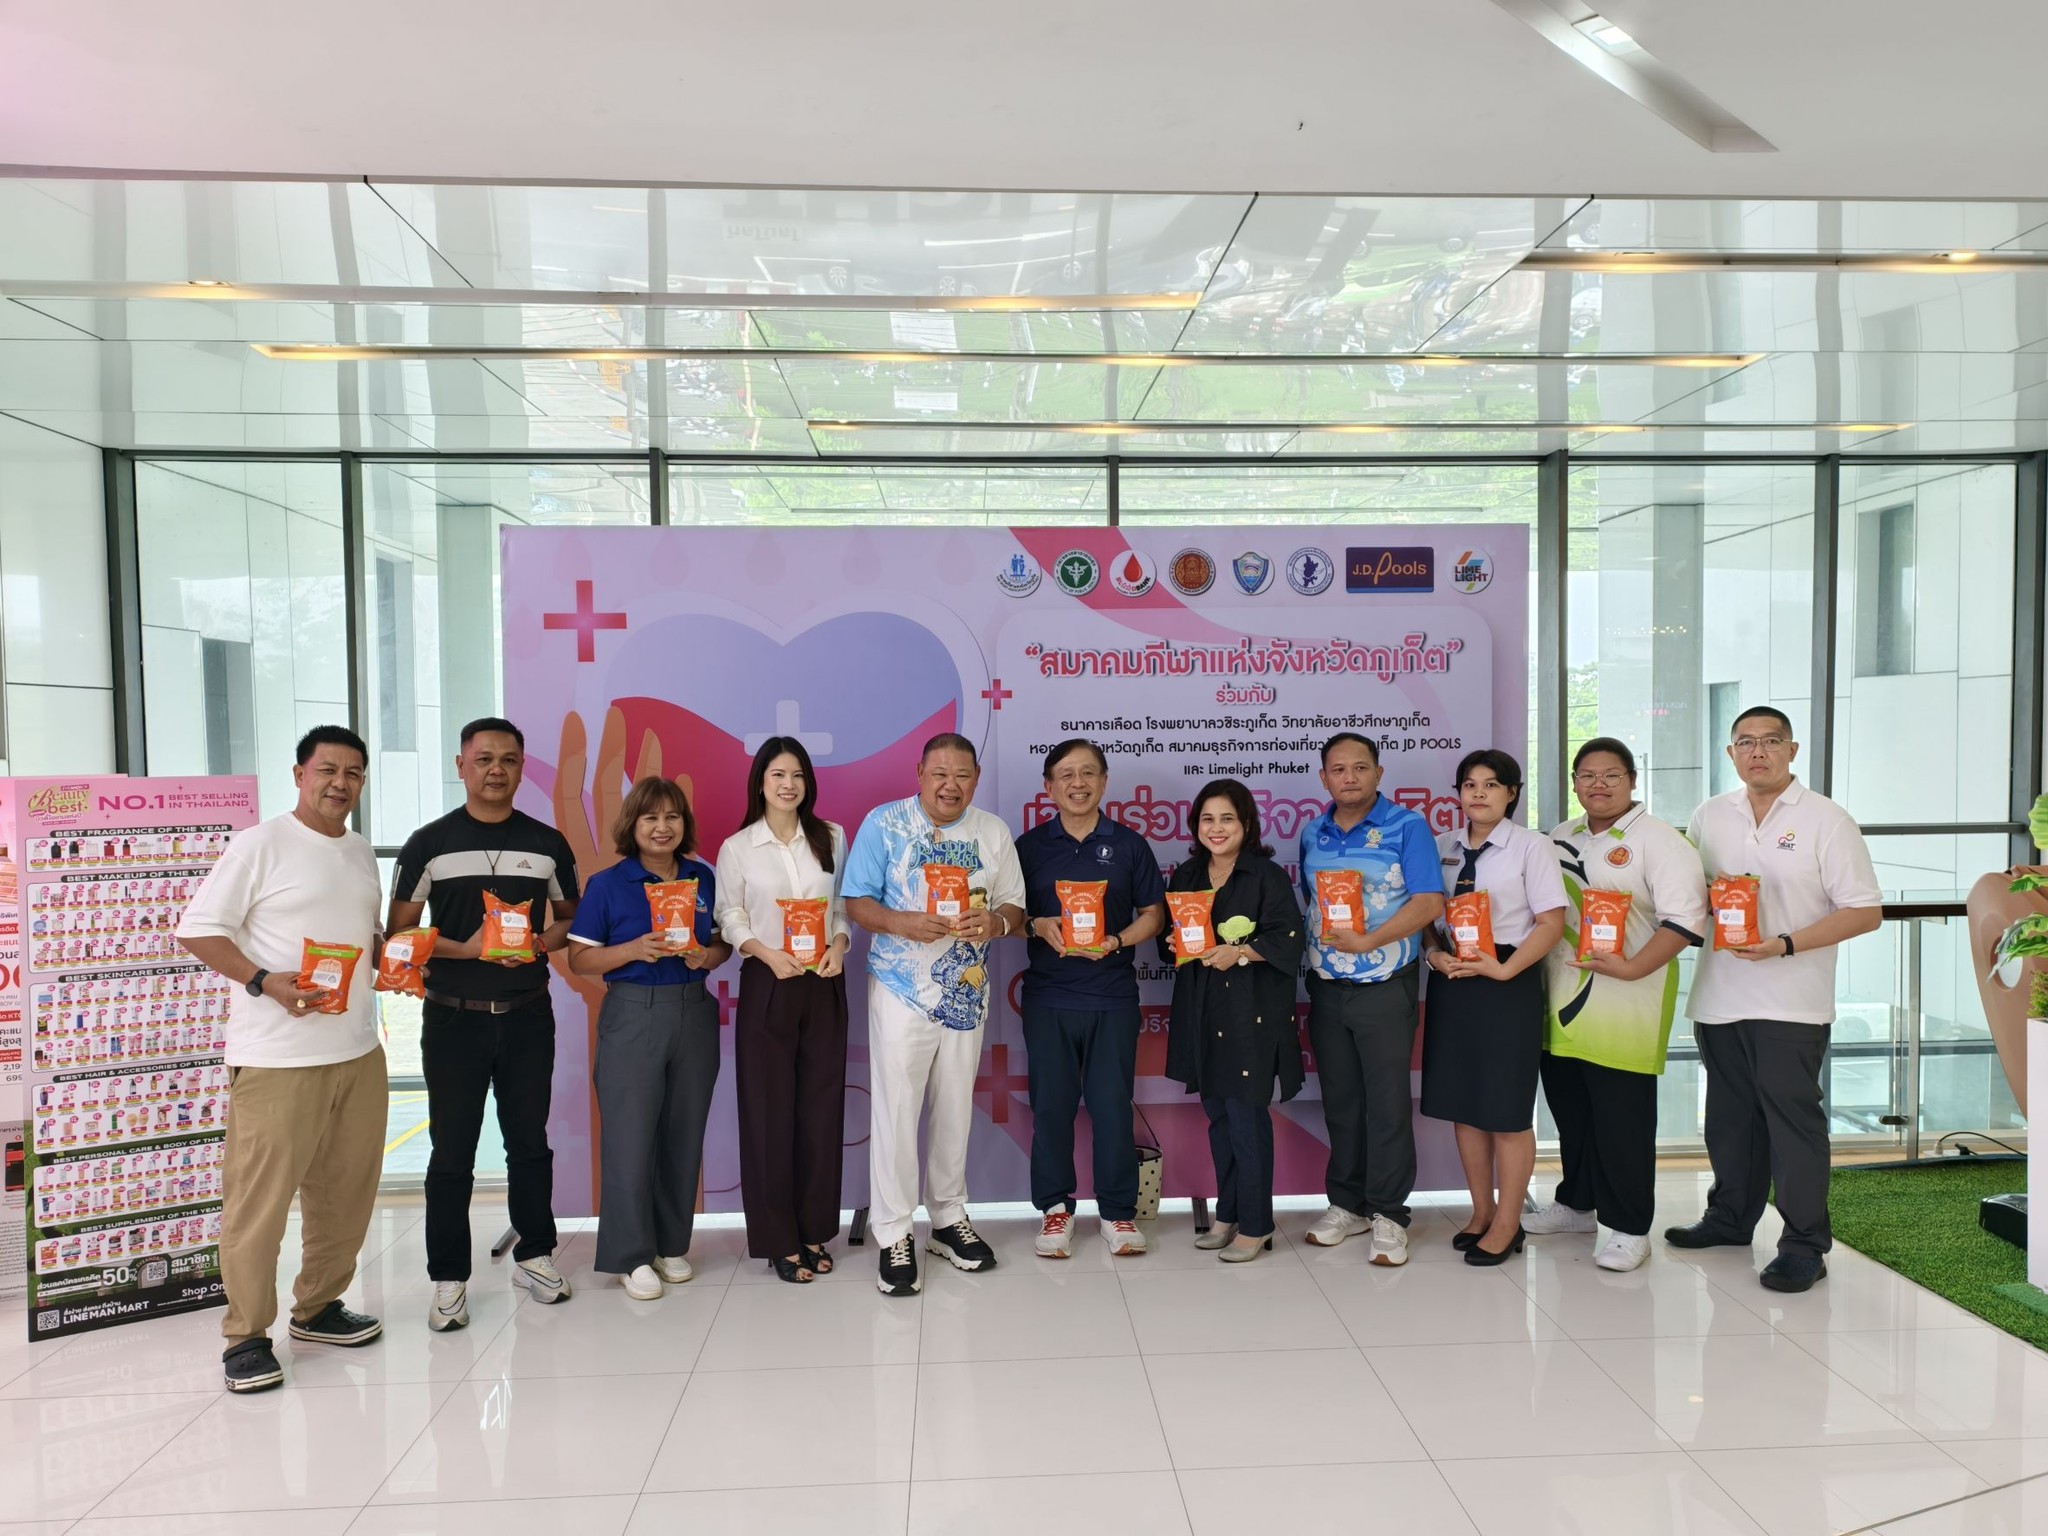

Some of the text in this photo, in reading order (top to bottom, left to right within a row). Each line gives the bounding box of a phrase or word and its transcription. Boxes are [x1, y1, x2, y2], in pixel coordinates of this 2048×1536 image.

[1352, 563, 1374, 575] J.D.
[1455, 565, 1482, 574] LIME
[1455, 573, 1489, 582] LIGHT
[1215, 683, 1275, 704] ร่วมกับ
[1060, 711, 1430, 733] ธนาคารเลือด โรงพยาบาลวชิระภูเก็ต วิทยาลัยอาชีวศึกษาภูเก็ต
[1402, 738, 1416, 752] JD
[1420, 738, 1461, 749] POOLS
[1184, 762, 1310, 778] และ Limelight Phuket
[28, 788, 88, 809] Beauty
[99, 794, 164, 811] NO.1
[186, 800, 249, 808] THAILAND
[48, 801, 82, 814] best
[87, 827, 154, 836] FRAGRANCE
[98, 872, 147, 880] MAKEUP
[65, 974, 95, 982] BEST
[97, 969, 153, 980] SKINCARE
[174, 966, 196, 974] THE
[3, 1063, 22, 1071] 2,19
[60, 1073, 82, 1081] BEST
[117, 1063, 178, 1073] ACCESSORIES
[53, 1156, 76, 1164] BEST
[79, 1150, 127, 1160] PERSONAL
[80, 1225, 103, 1233] BEST
[105, 1216, 166, 1229] SUPPLEMENT
[201, 1206, 222, 1215] YEAR
[171, 1253, 210, 1267] สมาชิก
[102, 1266, 130, 1287] 50
[129, 1274, 138, 1282] %
[182, 1286, 208, 1297] Shop
[117, 1300, 149, 1314] MART
